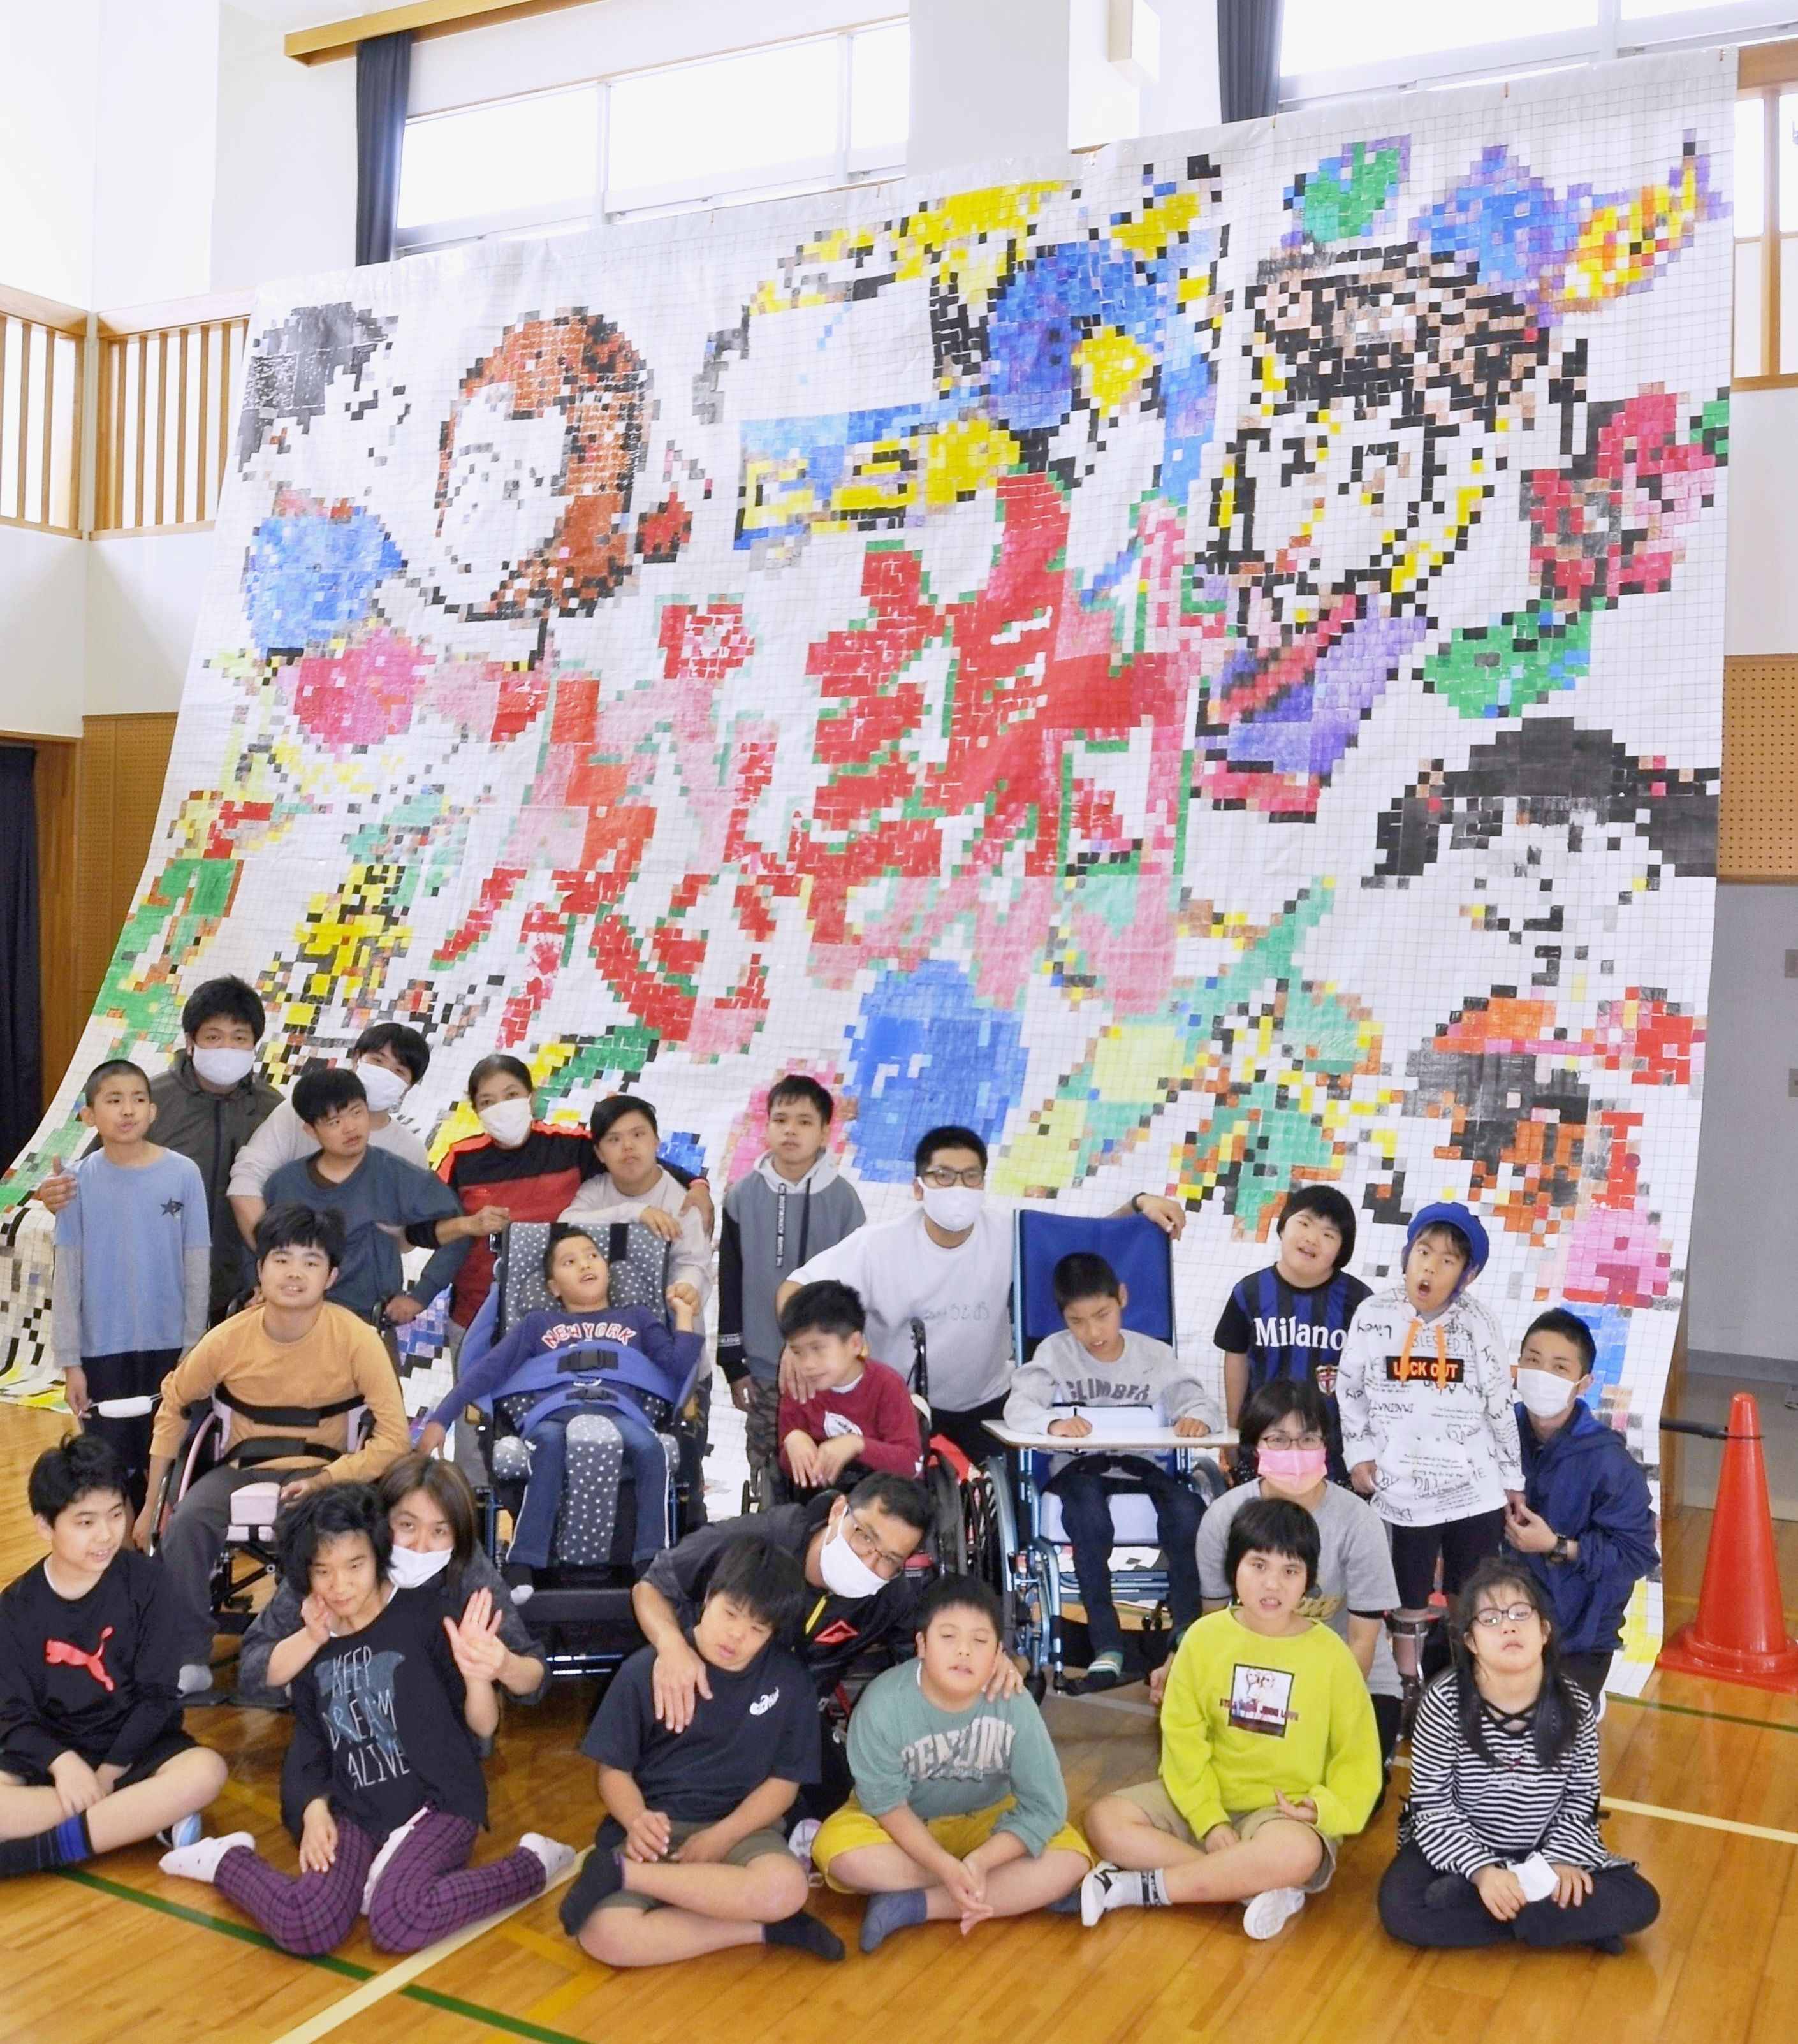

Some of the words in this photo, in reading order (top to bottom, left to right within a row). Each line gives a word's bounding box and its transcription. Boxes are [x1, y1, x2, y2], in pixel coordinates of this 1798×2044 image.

[434, 469, 1187, 1053] 感謝
[542, 1323, 582, 1350] NEW
[581, 1322, 637, 1347] YORK
[1253, 1315, 1347, 1351] Milano
[1412, 1334, 1460, 1352] BLESED
[1393, 1361, 1427, 1377] LCK
[332, 1645, 372, 1698] KEEP
[322, 1688, 397, 1751] DREAM
[348, 1740, 410, 1791] ALIVE
